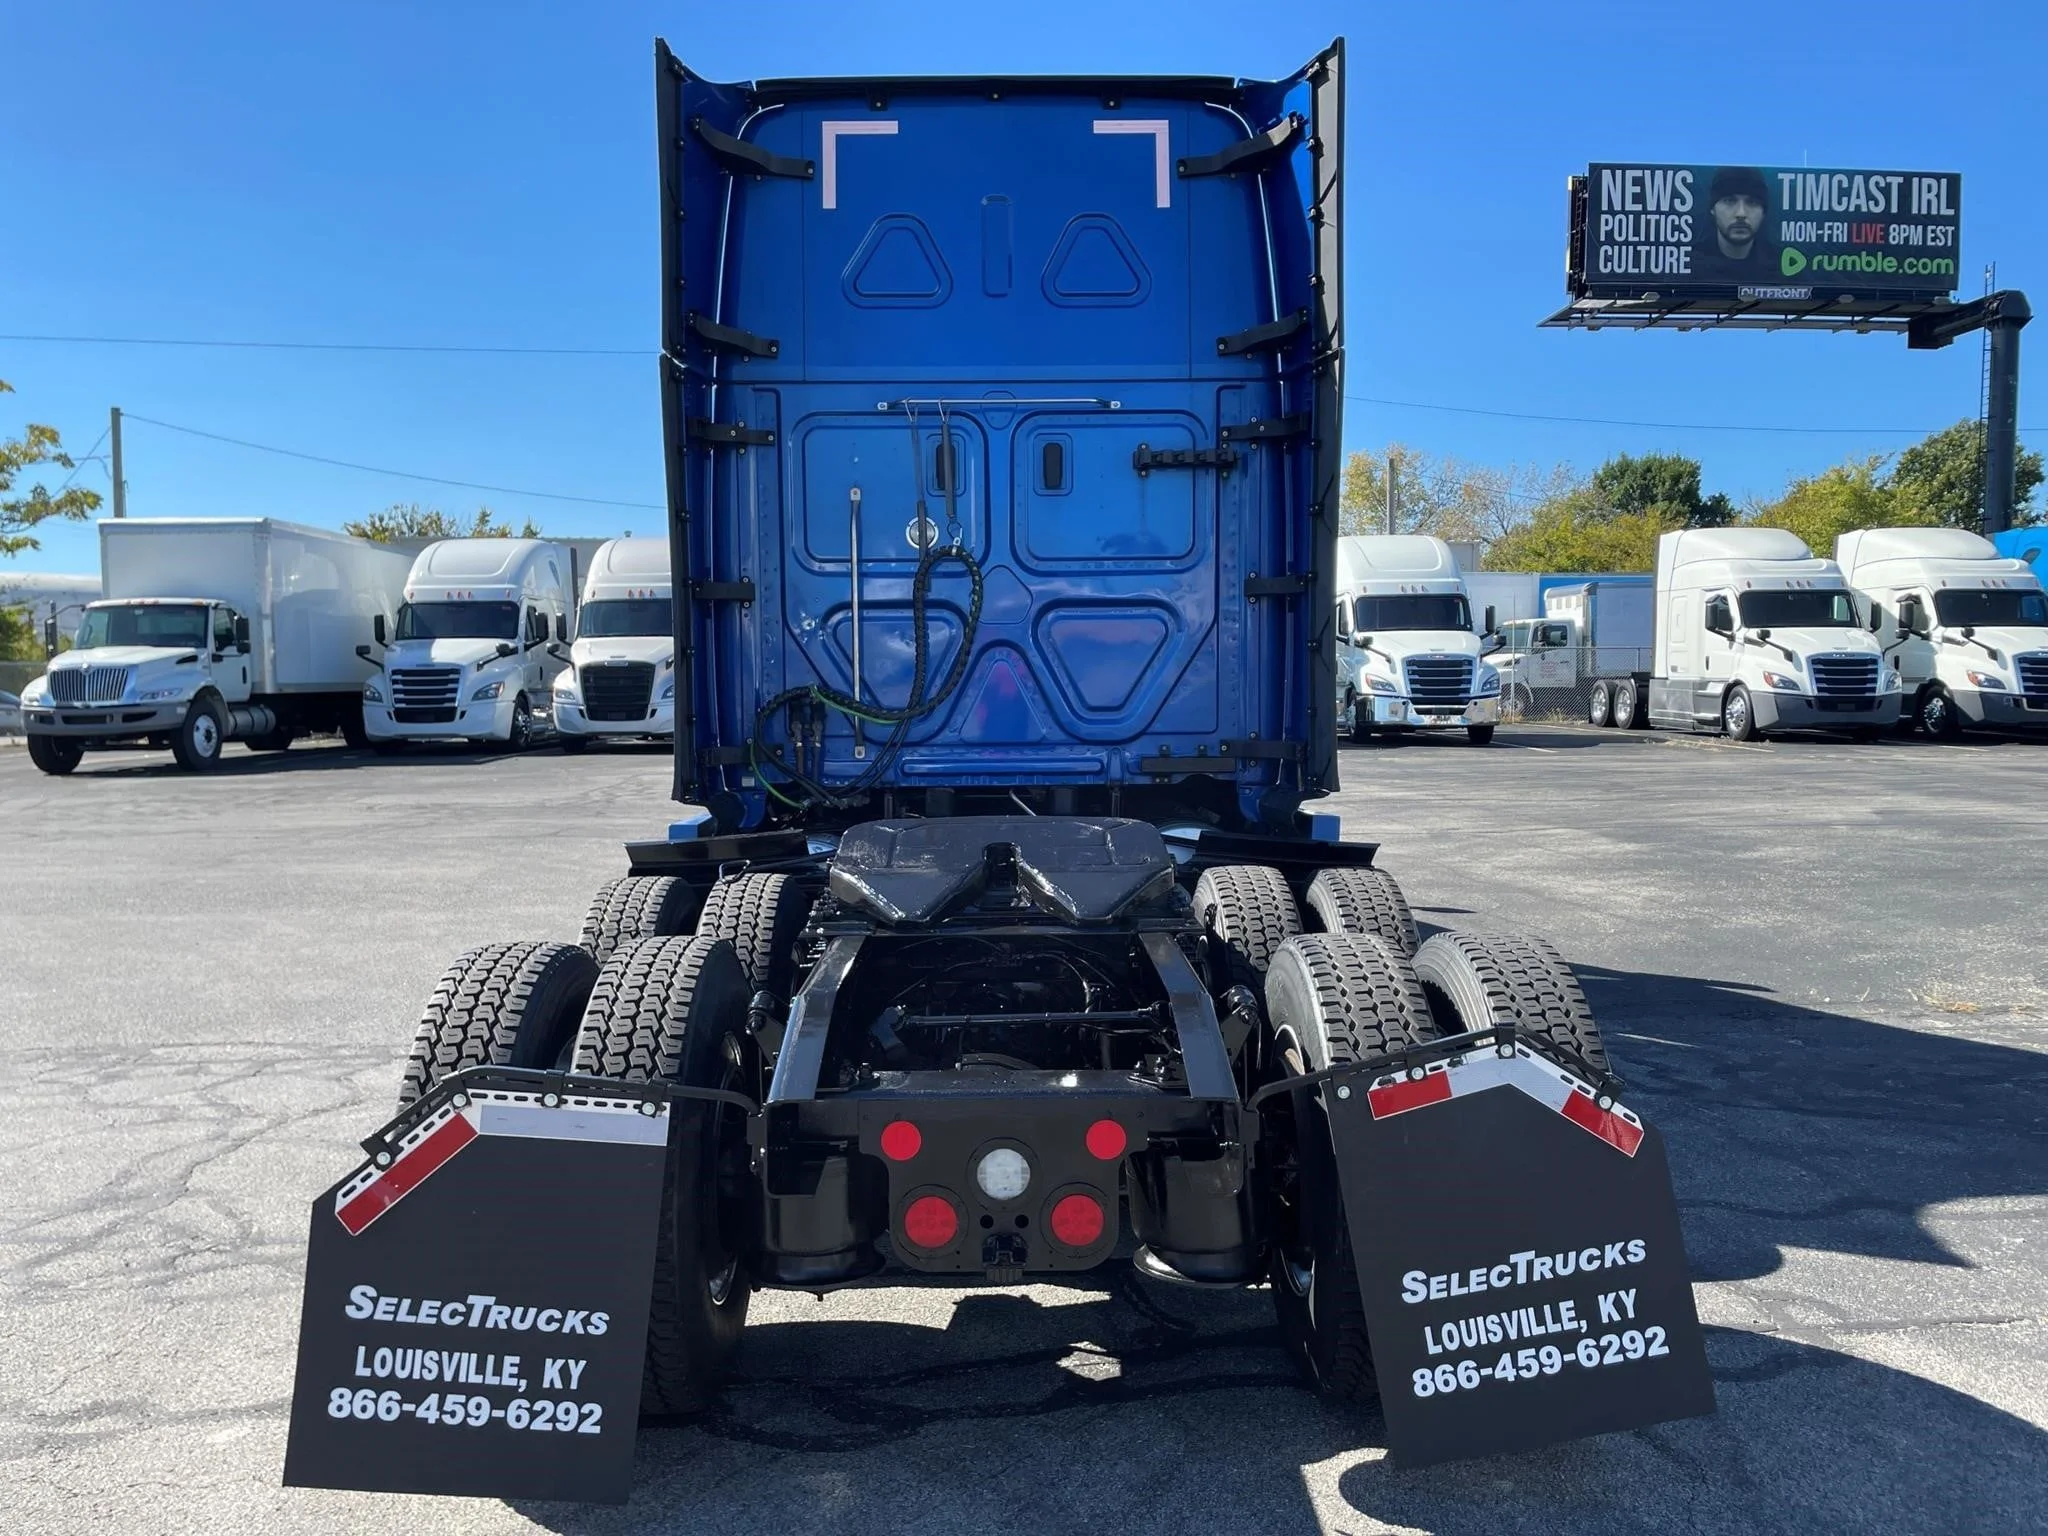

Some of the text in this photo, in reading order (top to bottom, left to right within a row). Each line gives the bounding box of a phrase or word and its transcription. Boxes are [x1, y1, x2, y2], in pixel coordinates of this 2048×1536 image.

[1601, 169, 1694, 212] NEWS
[1778, 172, 1955, 215] TIMCAST IRL
[1600, 214, 1693, 242] POLITICS
[1781, 221, 1955, 247] MON-FRI LIVE 8PM EST
[1600, 245, 1692, 274] CULTURE
[1812, 250, 1955, 276] rumble.com
[1424, 1288, 1637, 1355] LOUISVILLE, KY
[355, 1345, 587, 1393] LOUISVILLE, KY
[1412, 1325, 1670, 1398] 866-459-6292
[327, 1387, 603, 1434] 866-459-6292
